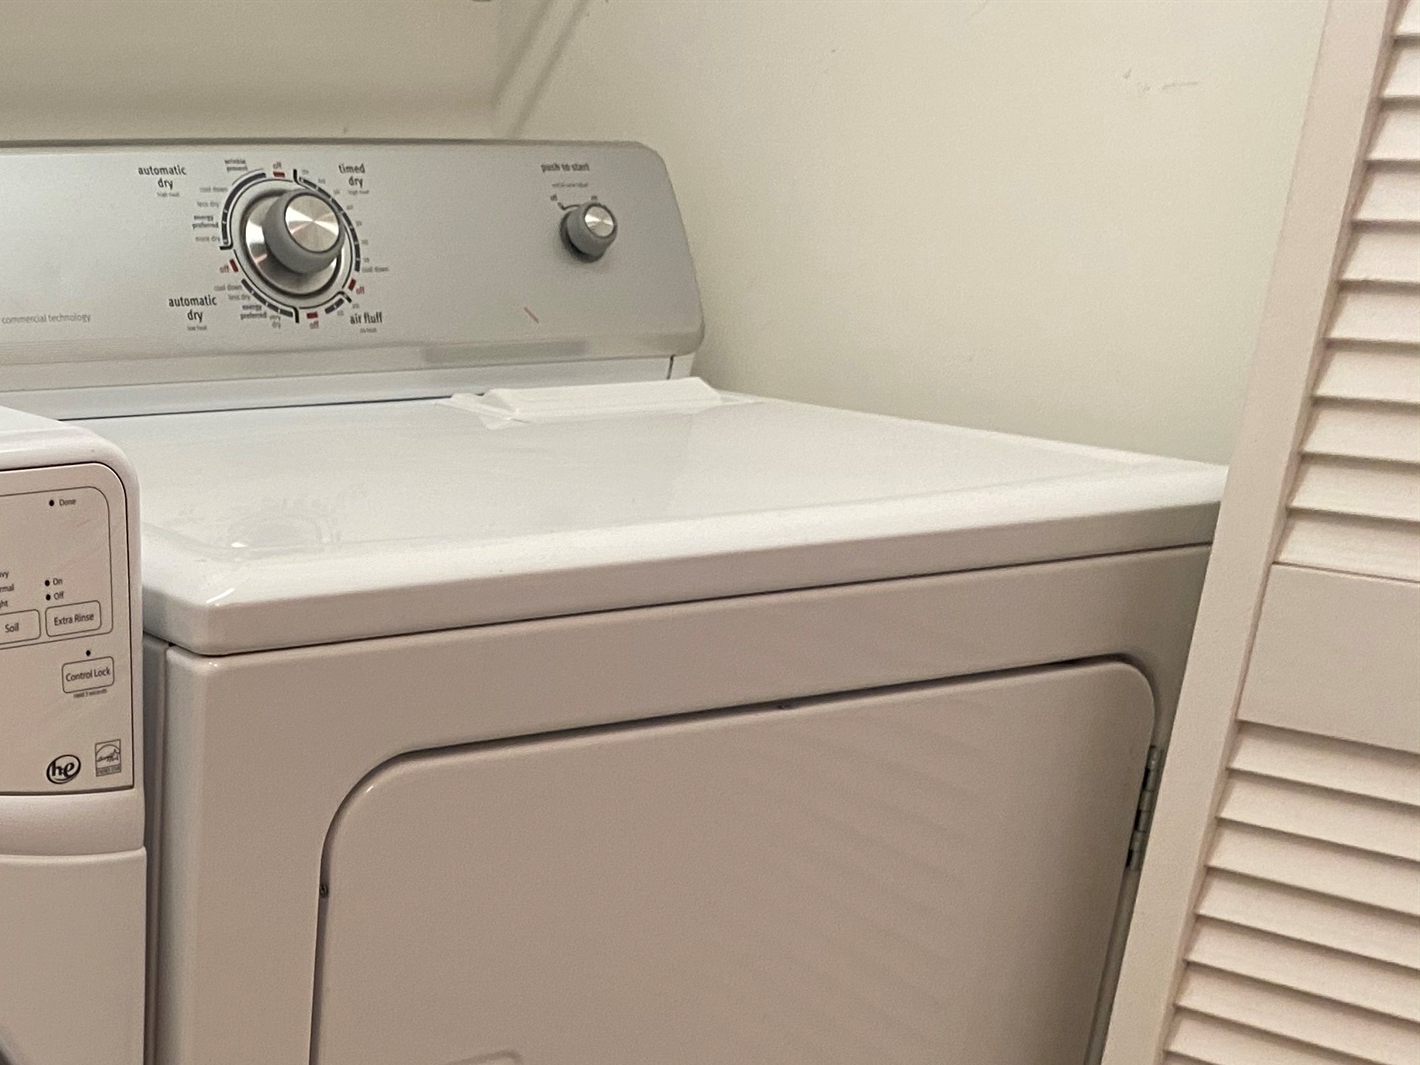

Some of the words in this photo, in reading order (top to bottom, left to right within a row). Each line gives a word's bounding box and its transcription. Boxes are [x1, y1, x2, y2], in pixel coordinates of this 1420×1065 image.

[138, 165, 187, 175] automatic
[338, 163, 365, 174] timed
[157, 178, 173, 190] dry
[348, 176, 363, 188] dry
[219, 264, 229, 273] off
[168, 294, 217, 307] automatic
[1, 314, 46, 325] commercial
[48, 312, 91, 323] technology
[187, 309, 204, 323] dry
[350, 313, 362, 325] air
[363, 311, 383, 324] fluff
[59, 498, 76, 506] Done
[52, 578, 63, 586] On
[53, 591, 65, 600] Off
[53, 616, 73, 626] Extra
[74, 613, 94, 623] Rinse
[4, 622, 20, 633] Soil
[65, 669, 93, 682] Control
[93, 667, 111, 677] Lock
